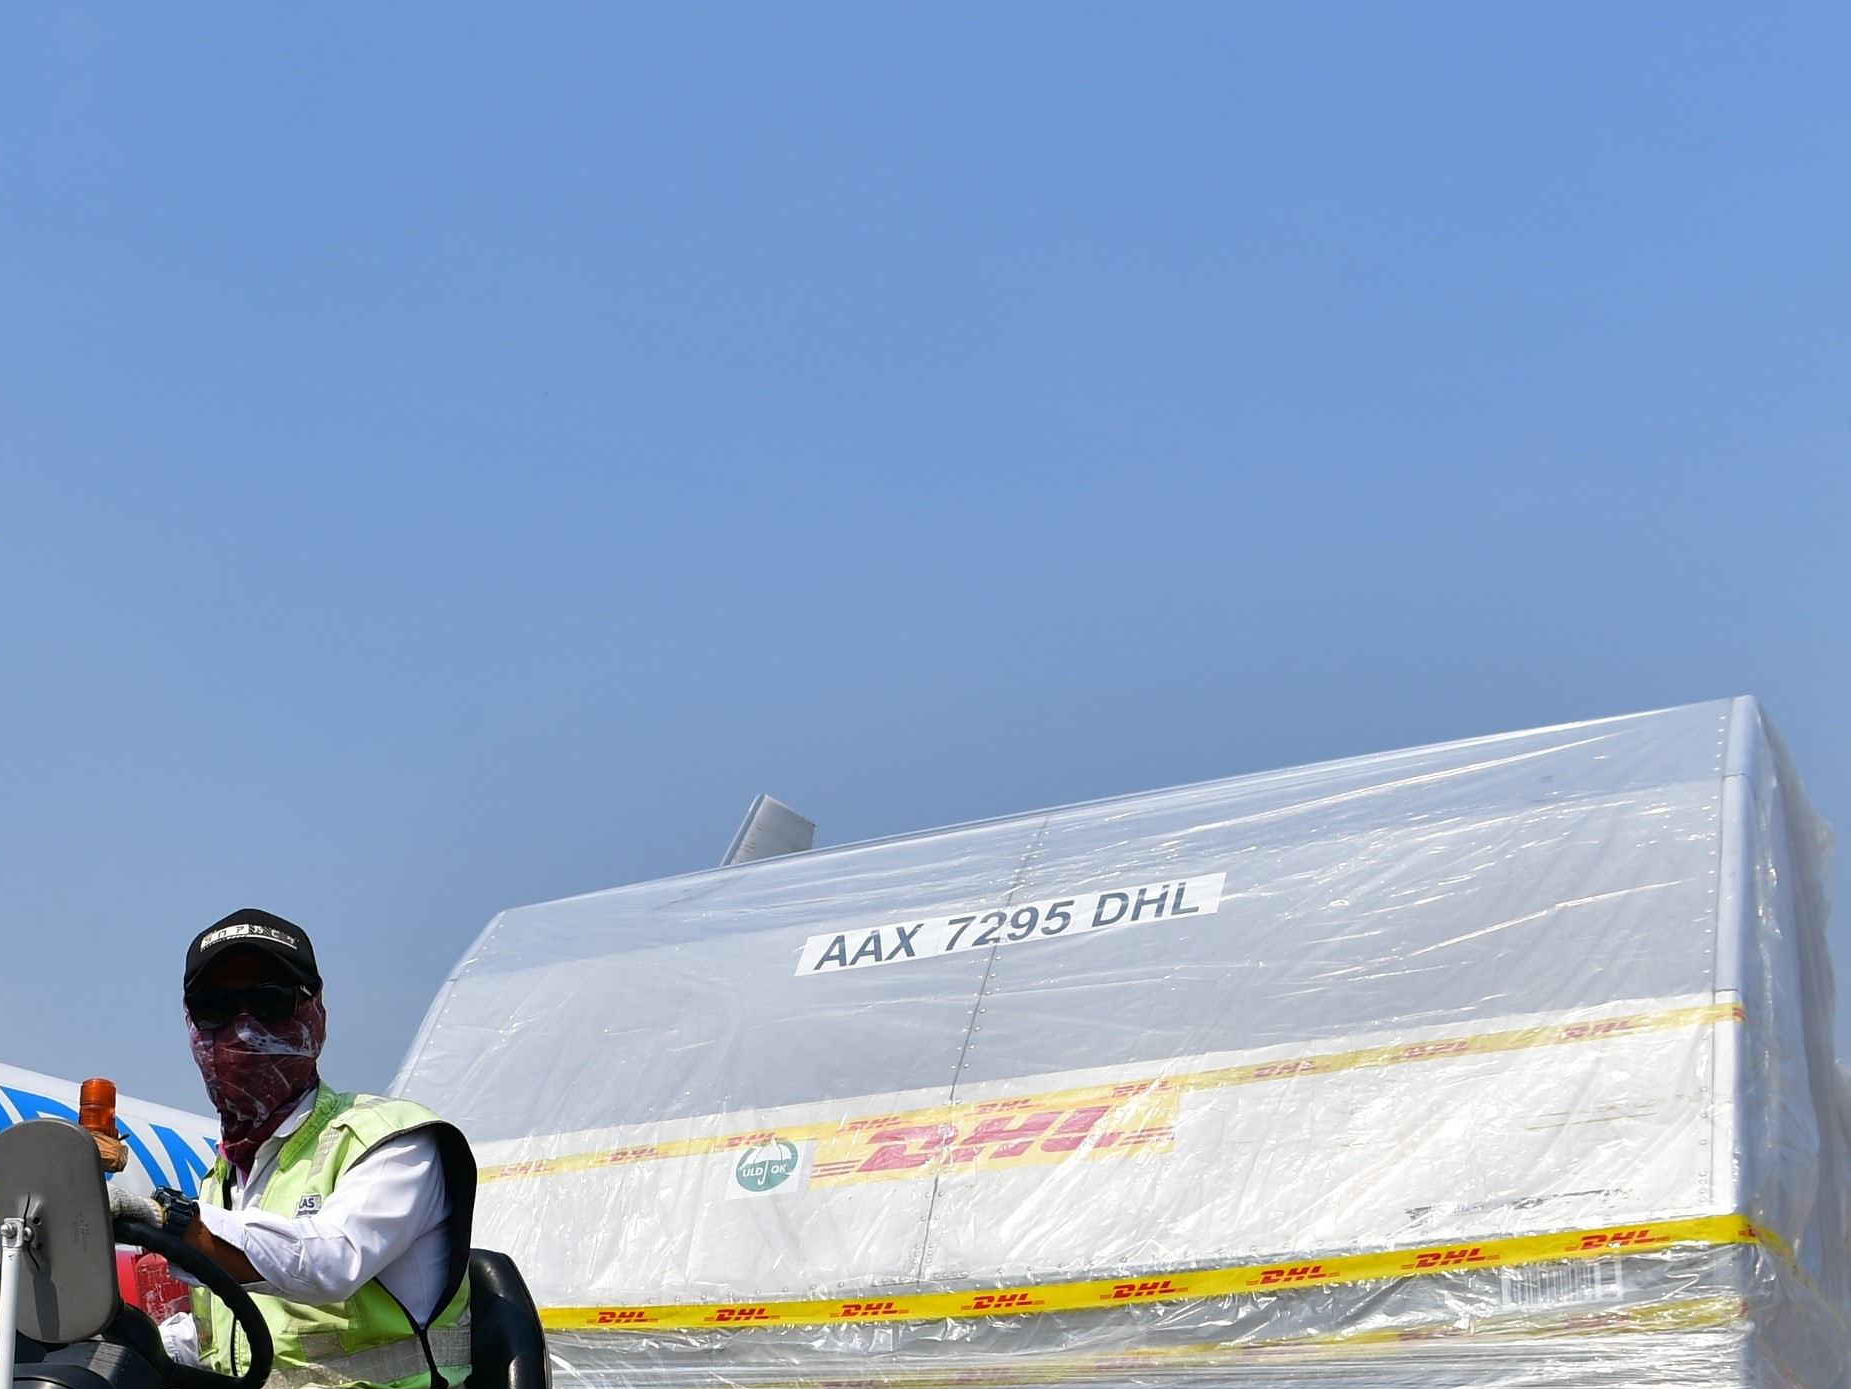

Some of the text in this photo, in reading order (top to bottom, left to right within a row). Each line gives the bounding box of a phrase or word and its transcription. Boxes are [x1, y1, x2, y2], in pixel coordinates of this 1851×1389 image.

[813, 882, 1200, 971] AAX 7295 DHL
[742, 1162, 788, 1178] ULD OK
[856, 1105, 1121, 1173] DHL
[597, 1229, 1659, 1324] DHL DHL DHL DHL DHL DHL DHL DHL
